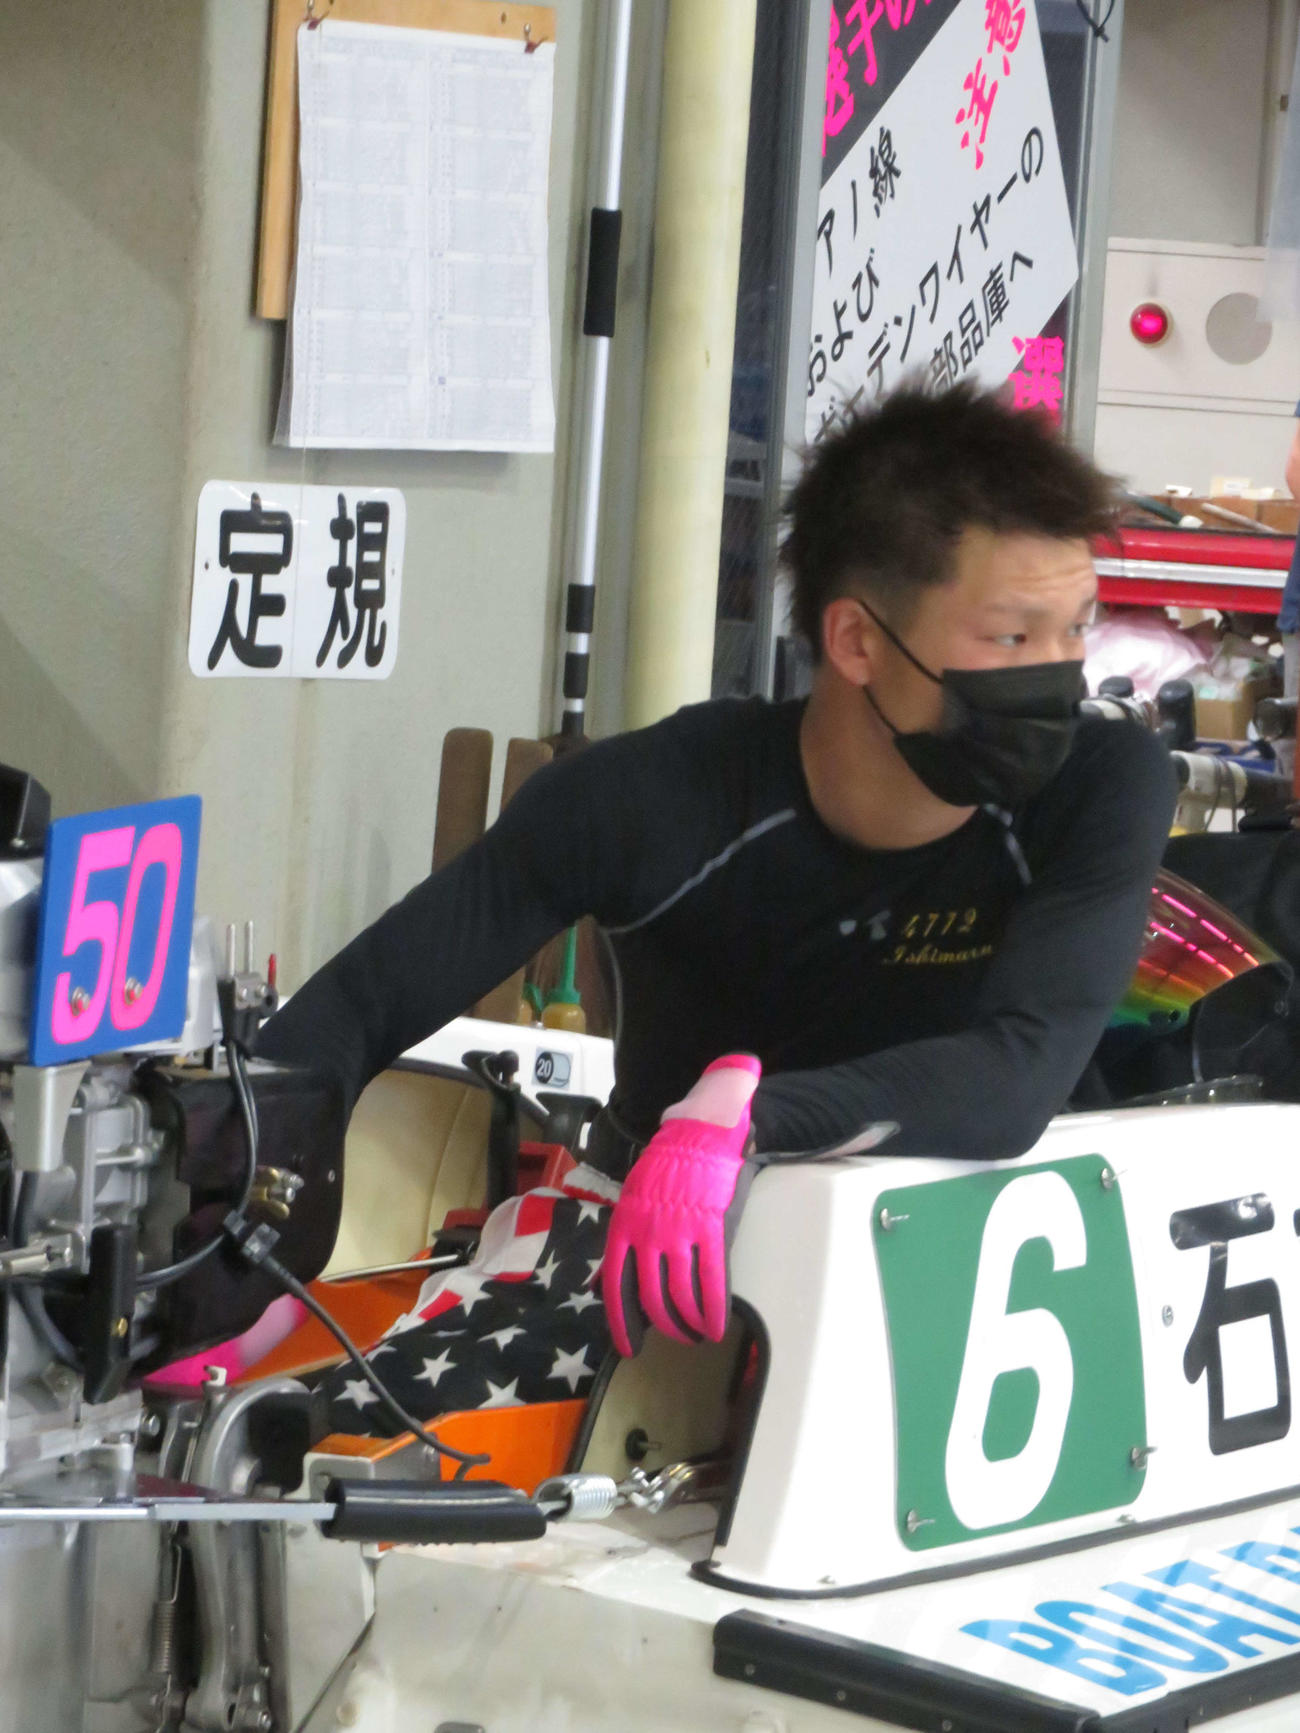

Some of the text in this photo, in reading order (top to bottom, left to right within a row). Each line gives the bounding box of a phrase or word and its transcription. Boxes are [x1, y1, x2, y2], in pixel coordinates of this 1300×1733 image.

[207, 492, 390, 671] 定規
[51, 822, 183, 1045] 50
[537, 1058, 551, 1077] 20
[945, 1171, 1088, 1531] 6
[1169, 1192, 1300, 1456] 石
